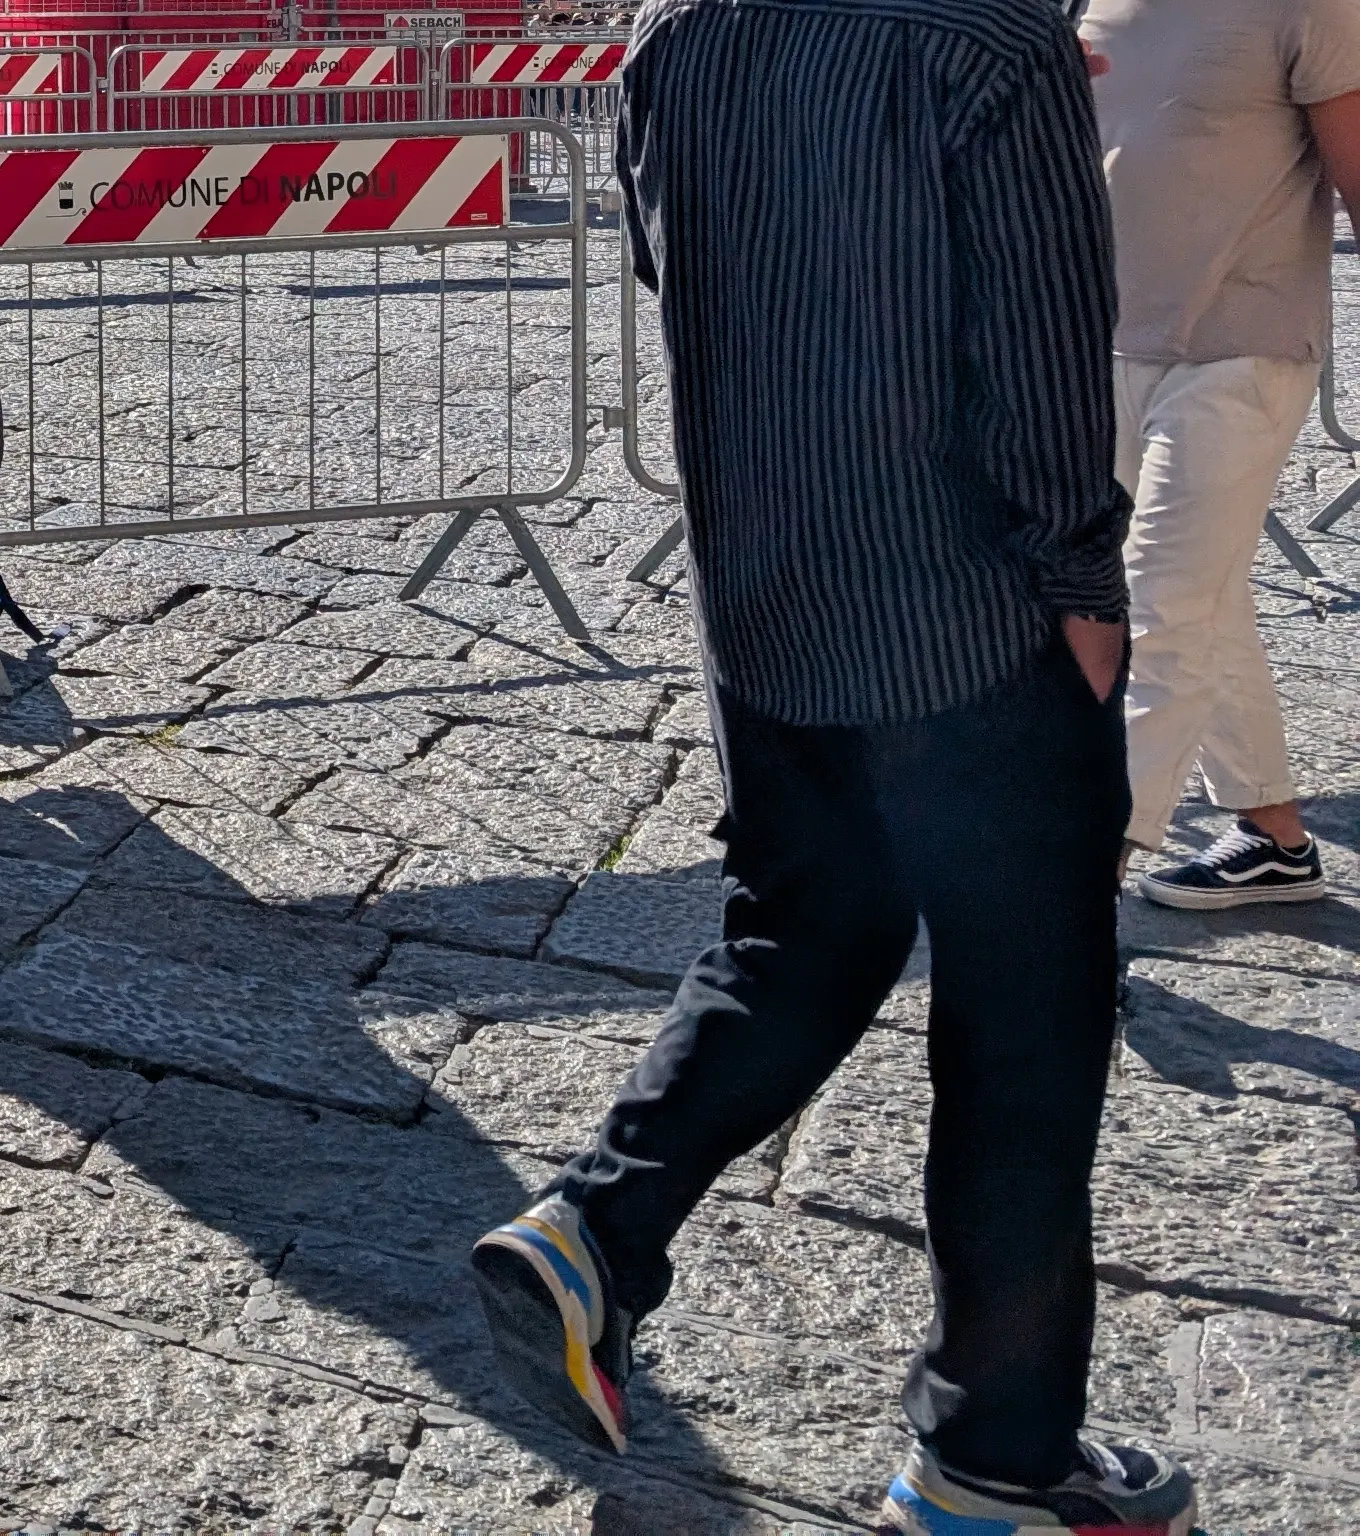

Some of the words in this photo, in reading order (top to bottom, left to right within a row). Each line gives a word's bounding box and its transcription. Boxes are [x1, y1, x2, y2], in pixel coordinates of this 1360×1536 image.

[410, 17, 461, 28] SEBACH
[224, 62, 281, 75] COMUNE
[302, 61, 351, 74] NAPOLI
[544, 56, 594, 69] CUNE
[89, 177, 229, 211] COMUNE
[240, 176, 270, 206] DI
[280, 171, 397, 203] NAPOLI
